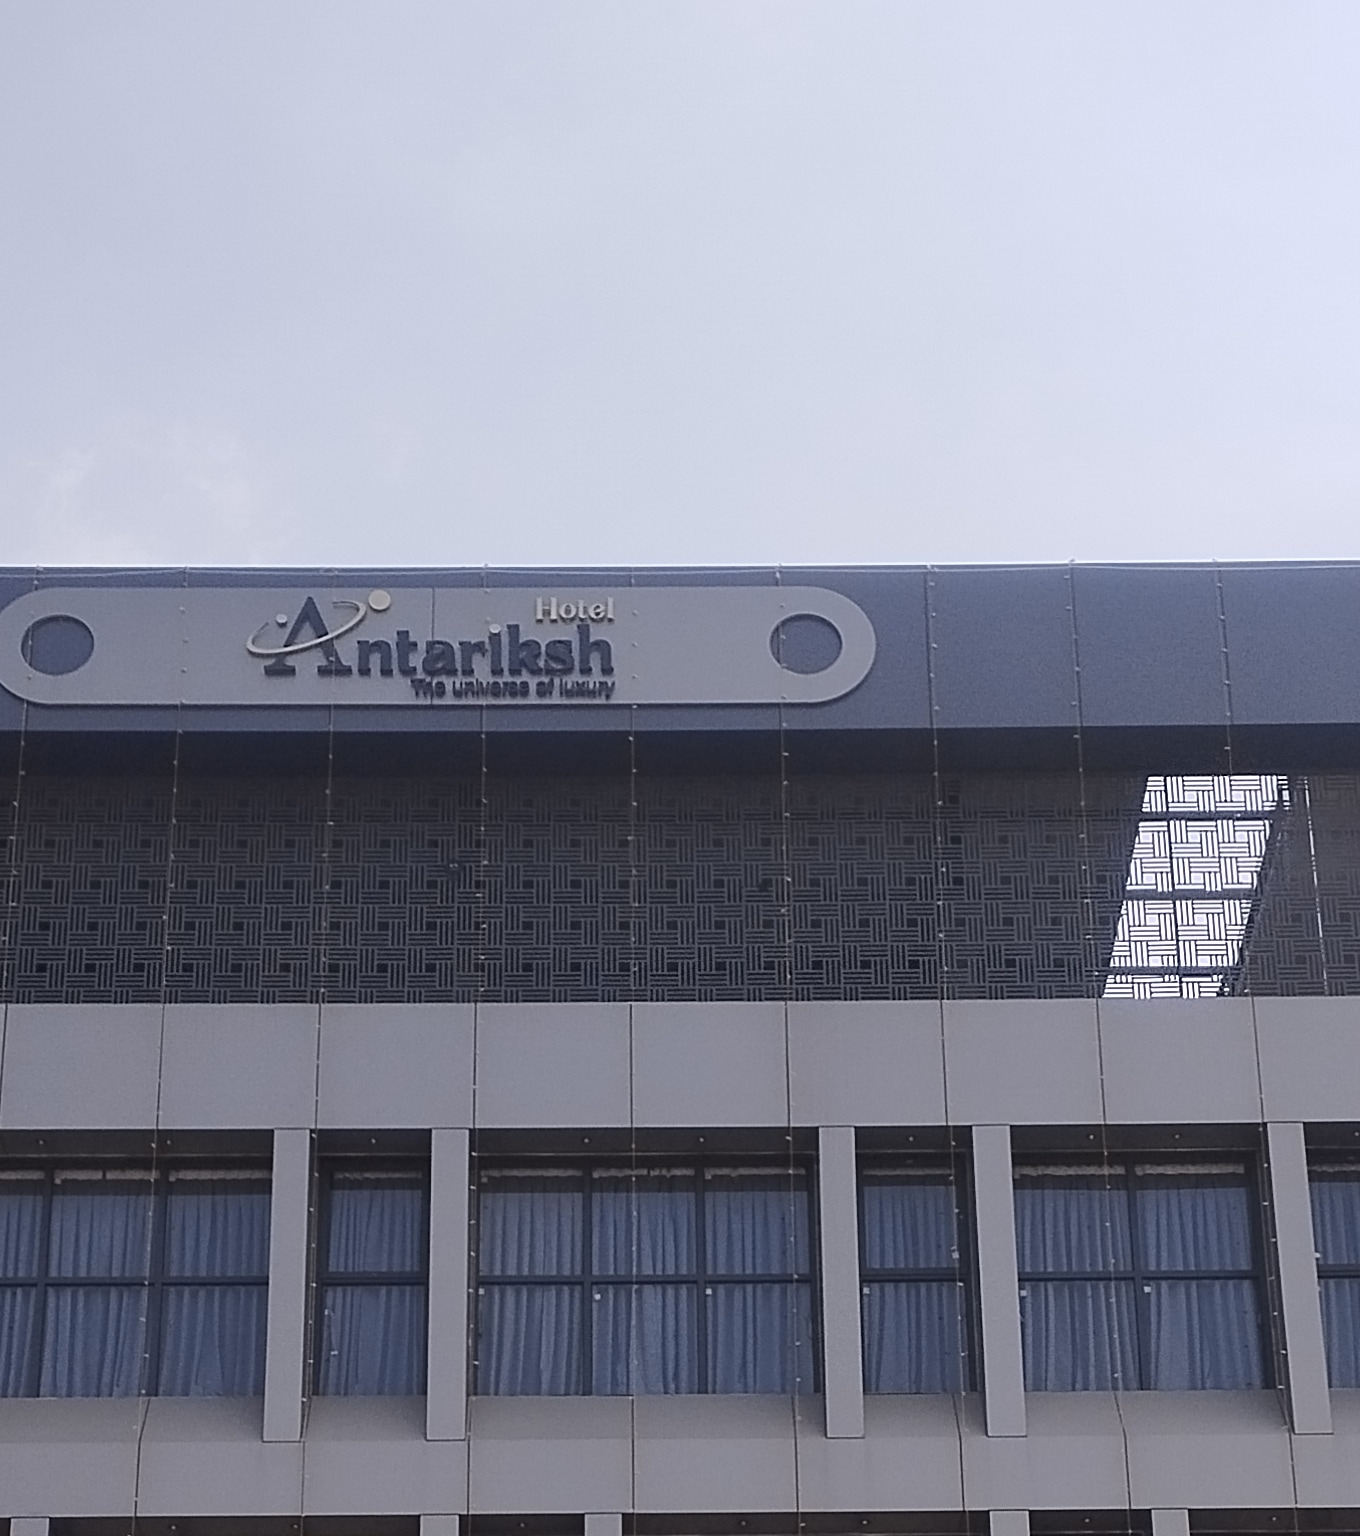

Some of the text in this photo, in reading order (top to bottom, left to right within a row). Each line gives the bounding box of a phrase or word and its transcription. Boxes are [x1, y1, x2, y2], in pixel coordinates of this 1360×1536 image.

[535, 597, 615, 623] Hotel
[263, 596, 615, 677] Antariksh
[410, 678, 616, 700] The universe of luxury
